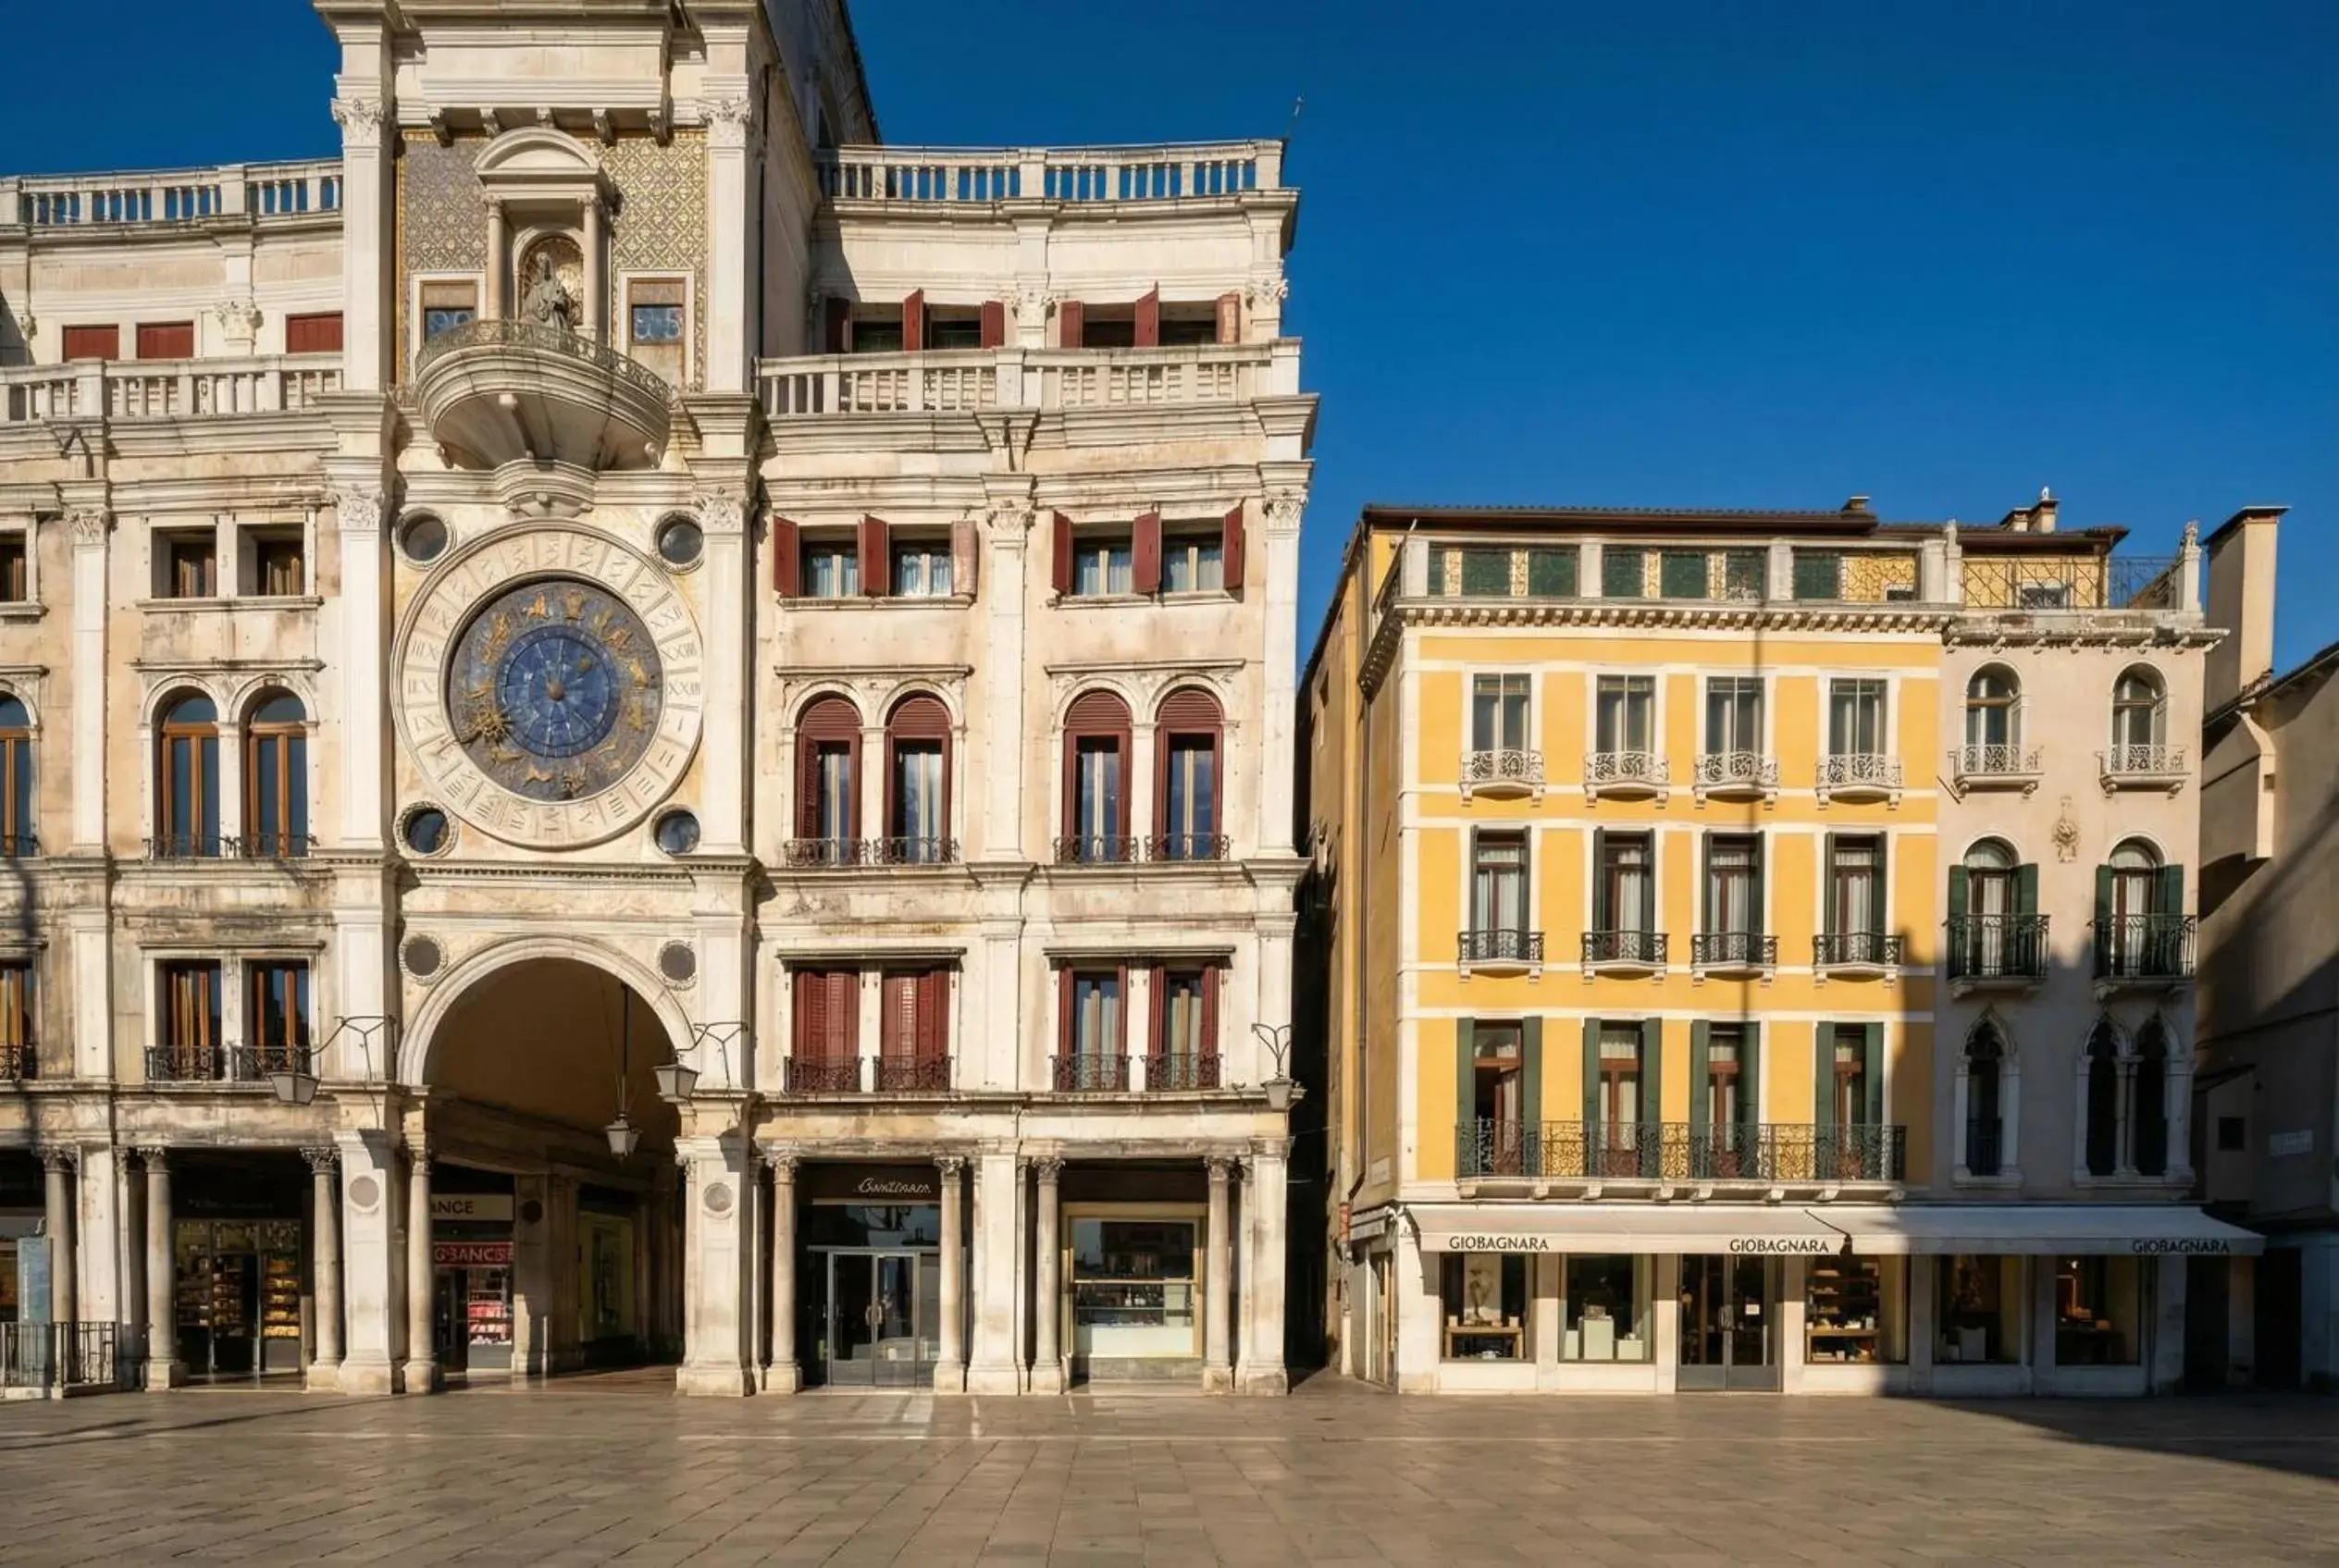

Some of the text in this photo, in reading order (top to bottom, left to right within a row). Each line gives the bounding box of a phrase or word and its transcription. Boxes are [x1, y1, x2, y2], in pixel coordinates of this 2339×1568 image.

[660, 750, 674, 767] II
[637, 777, 654, 795] III
[609, 796, 627, 818] IIII
[1449, 1235, 1549, 1251] GIOBAGNARA
[1729, 1239, 1829, 1253] GIOBAGNARA
[2132, 1240, 2230, 1253] GIOBAGNARA
